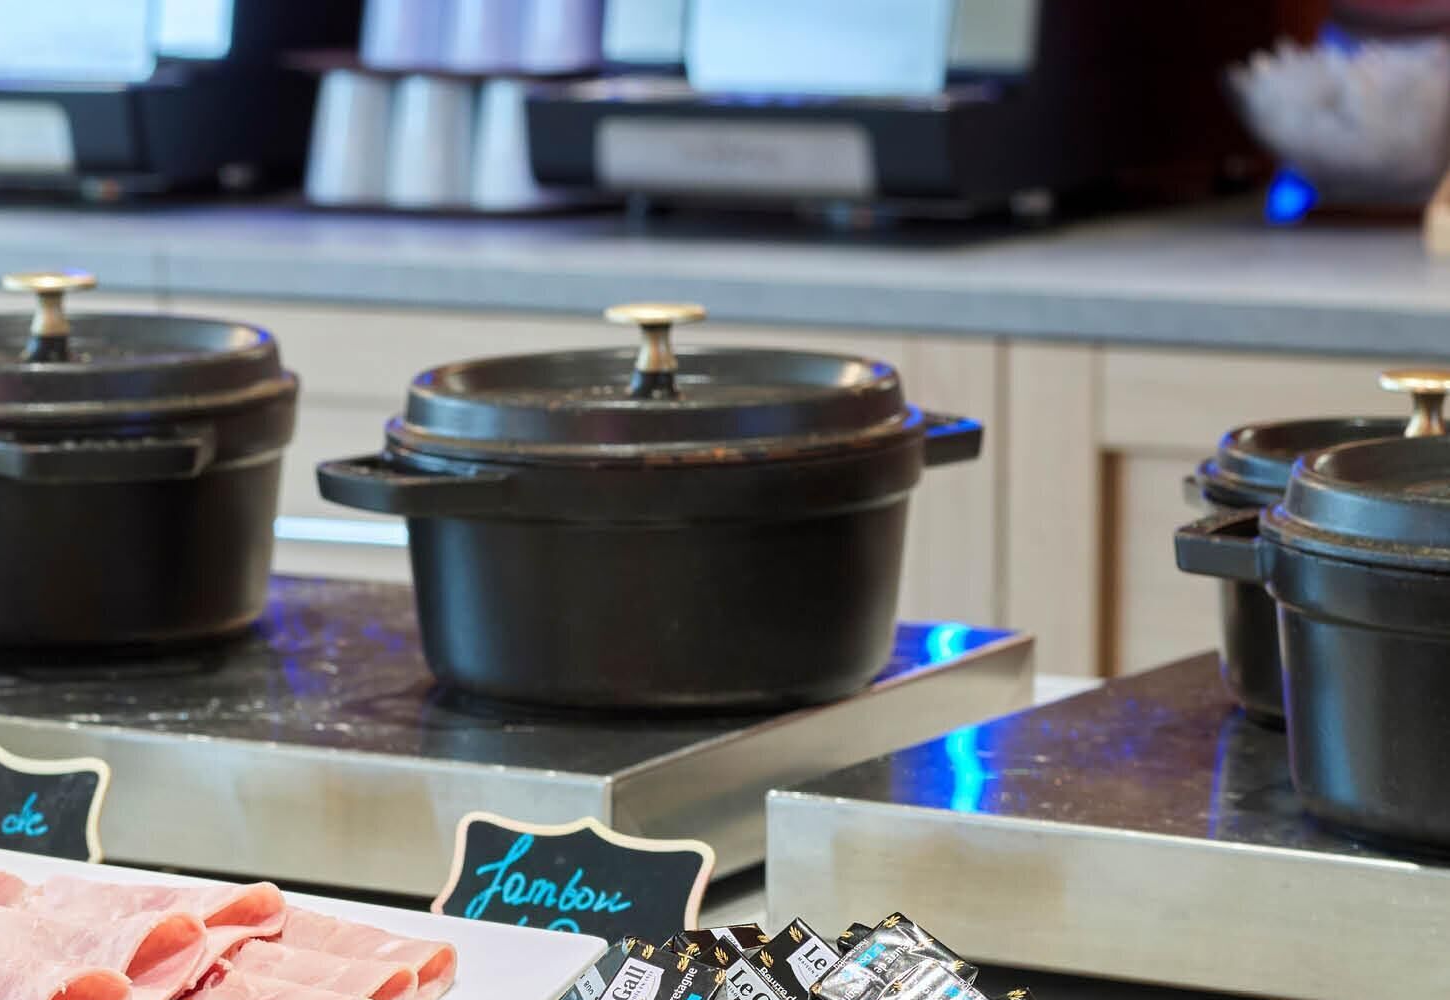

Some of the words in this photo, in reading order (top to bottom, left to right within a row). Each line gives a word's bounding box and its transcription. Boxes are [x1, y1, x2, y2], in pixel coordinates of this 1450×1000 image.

[1, 792, 48, 836] de
[465, 833, 631, 919] Jambon
[804, 944, 831, 970] Le
[729, 968, 757, 997] Le
